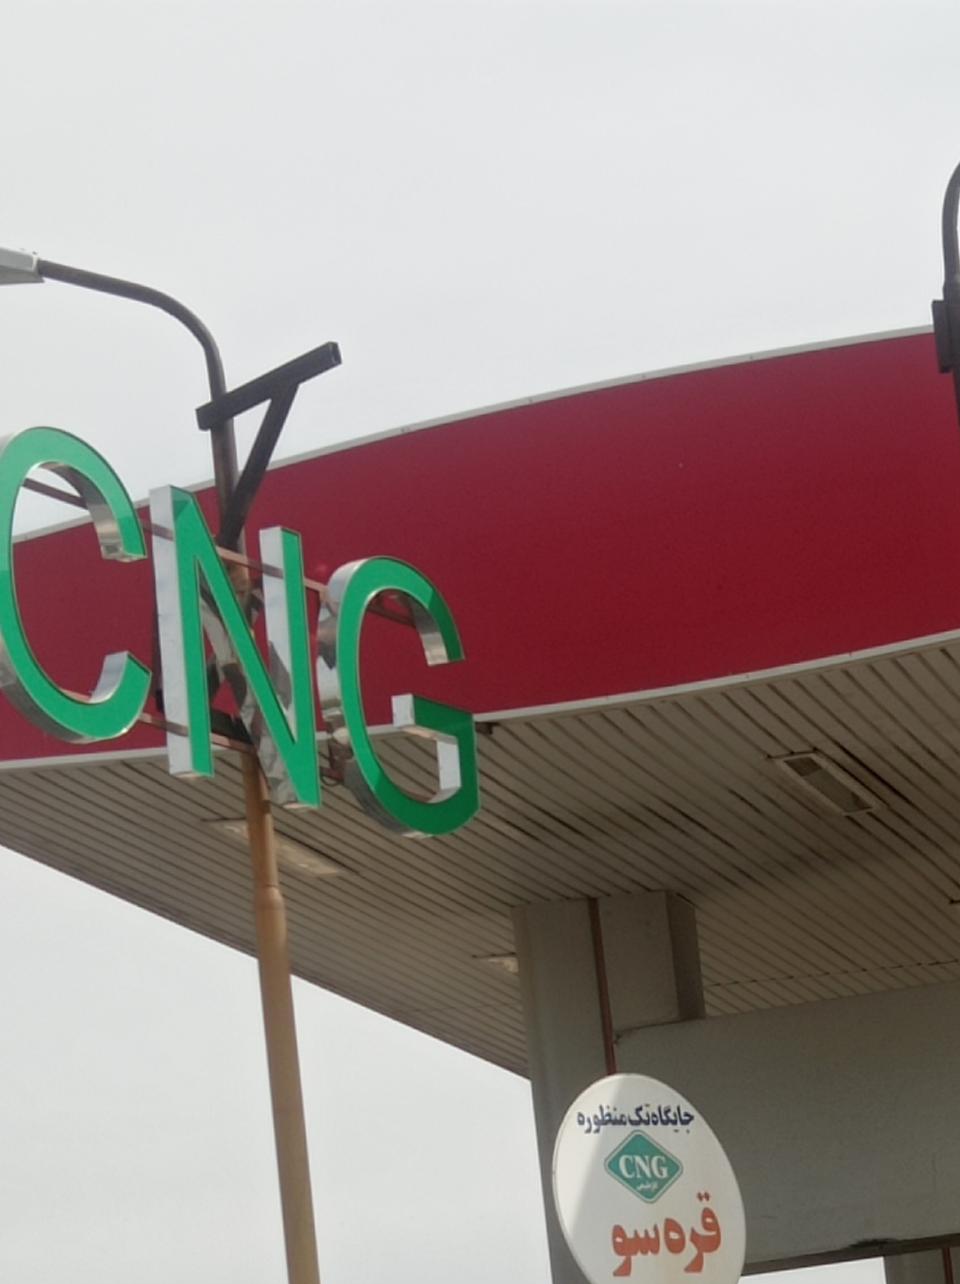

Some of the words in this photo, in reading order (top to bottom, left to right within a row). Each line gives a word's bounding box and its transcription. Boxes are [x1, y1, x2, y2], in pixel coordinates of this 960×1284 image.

[0, 427, 480, 838] CNG
[577, 1104, 628, 1134] منظوره
[651, 1104, 695, 1133] جایگاه
[618, 1154, 669, 1179] CNG
